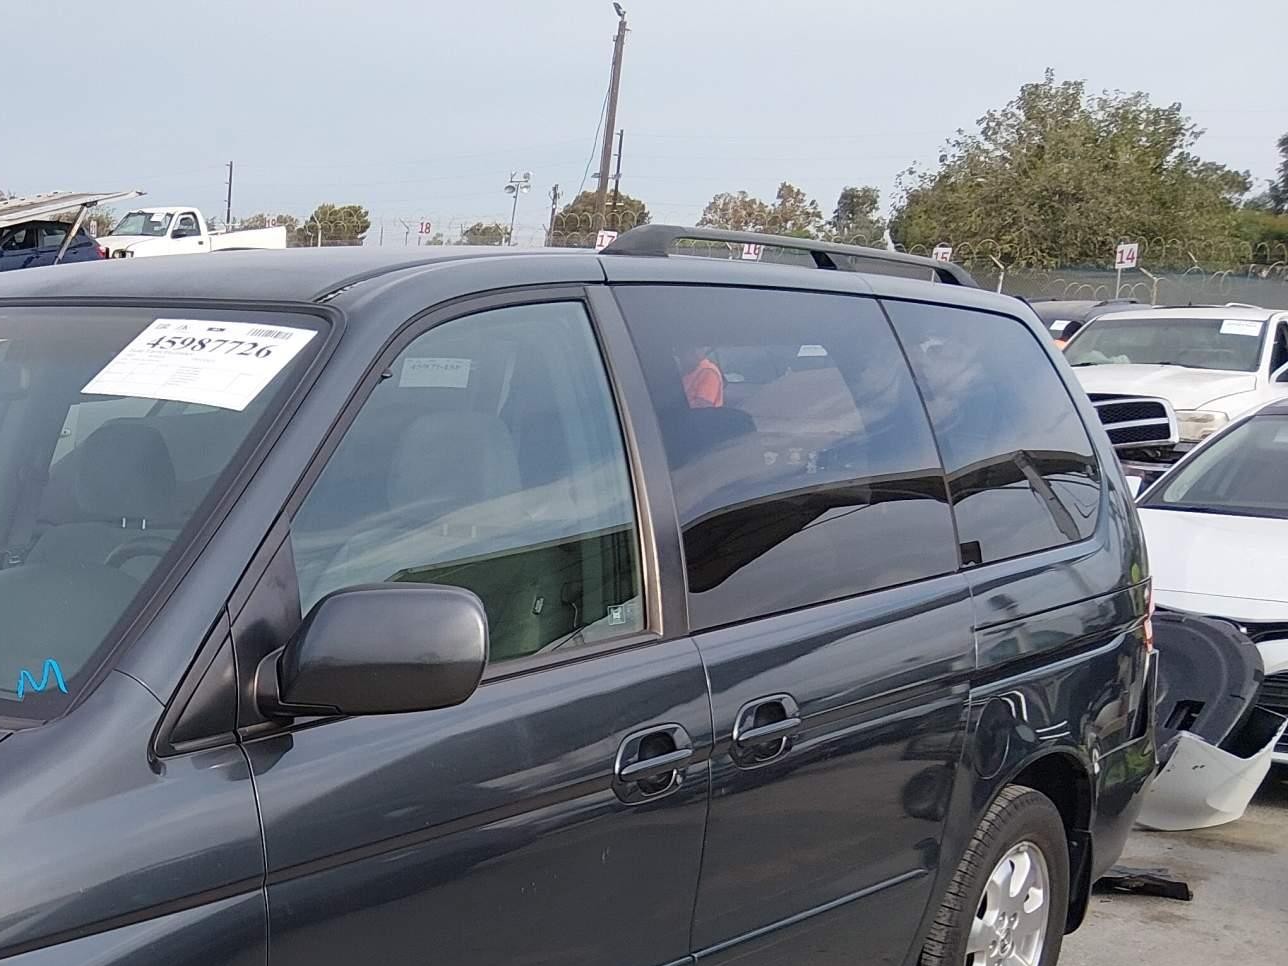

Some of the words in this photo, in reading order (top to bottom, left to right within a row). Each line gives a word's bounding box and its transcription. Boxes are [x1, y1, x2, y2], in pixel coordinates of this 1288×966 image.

[418, 222, 431, 234] 18
[1117, 248, 1136, 265] 14
[146, 335, 275, 359] 45987726
